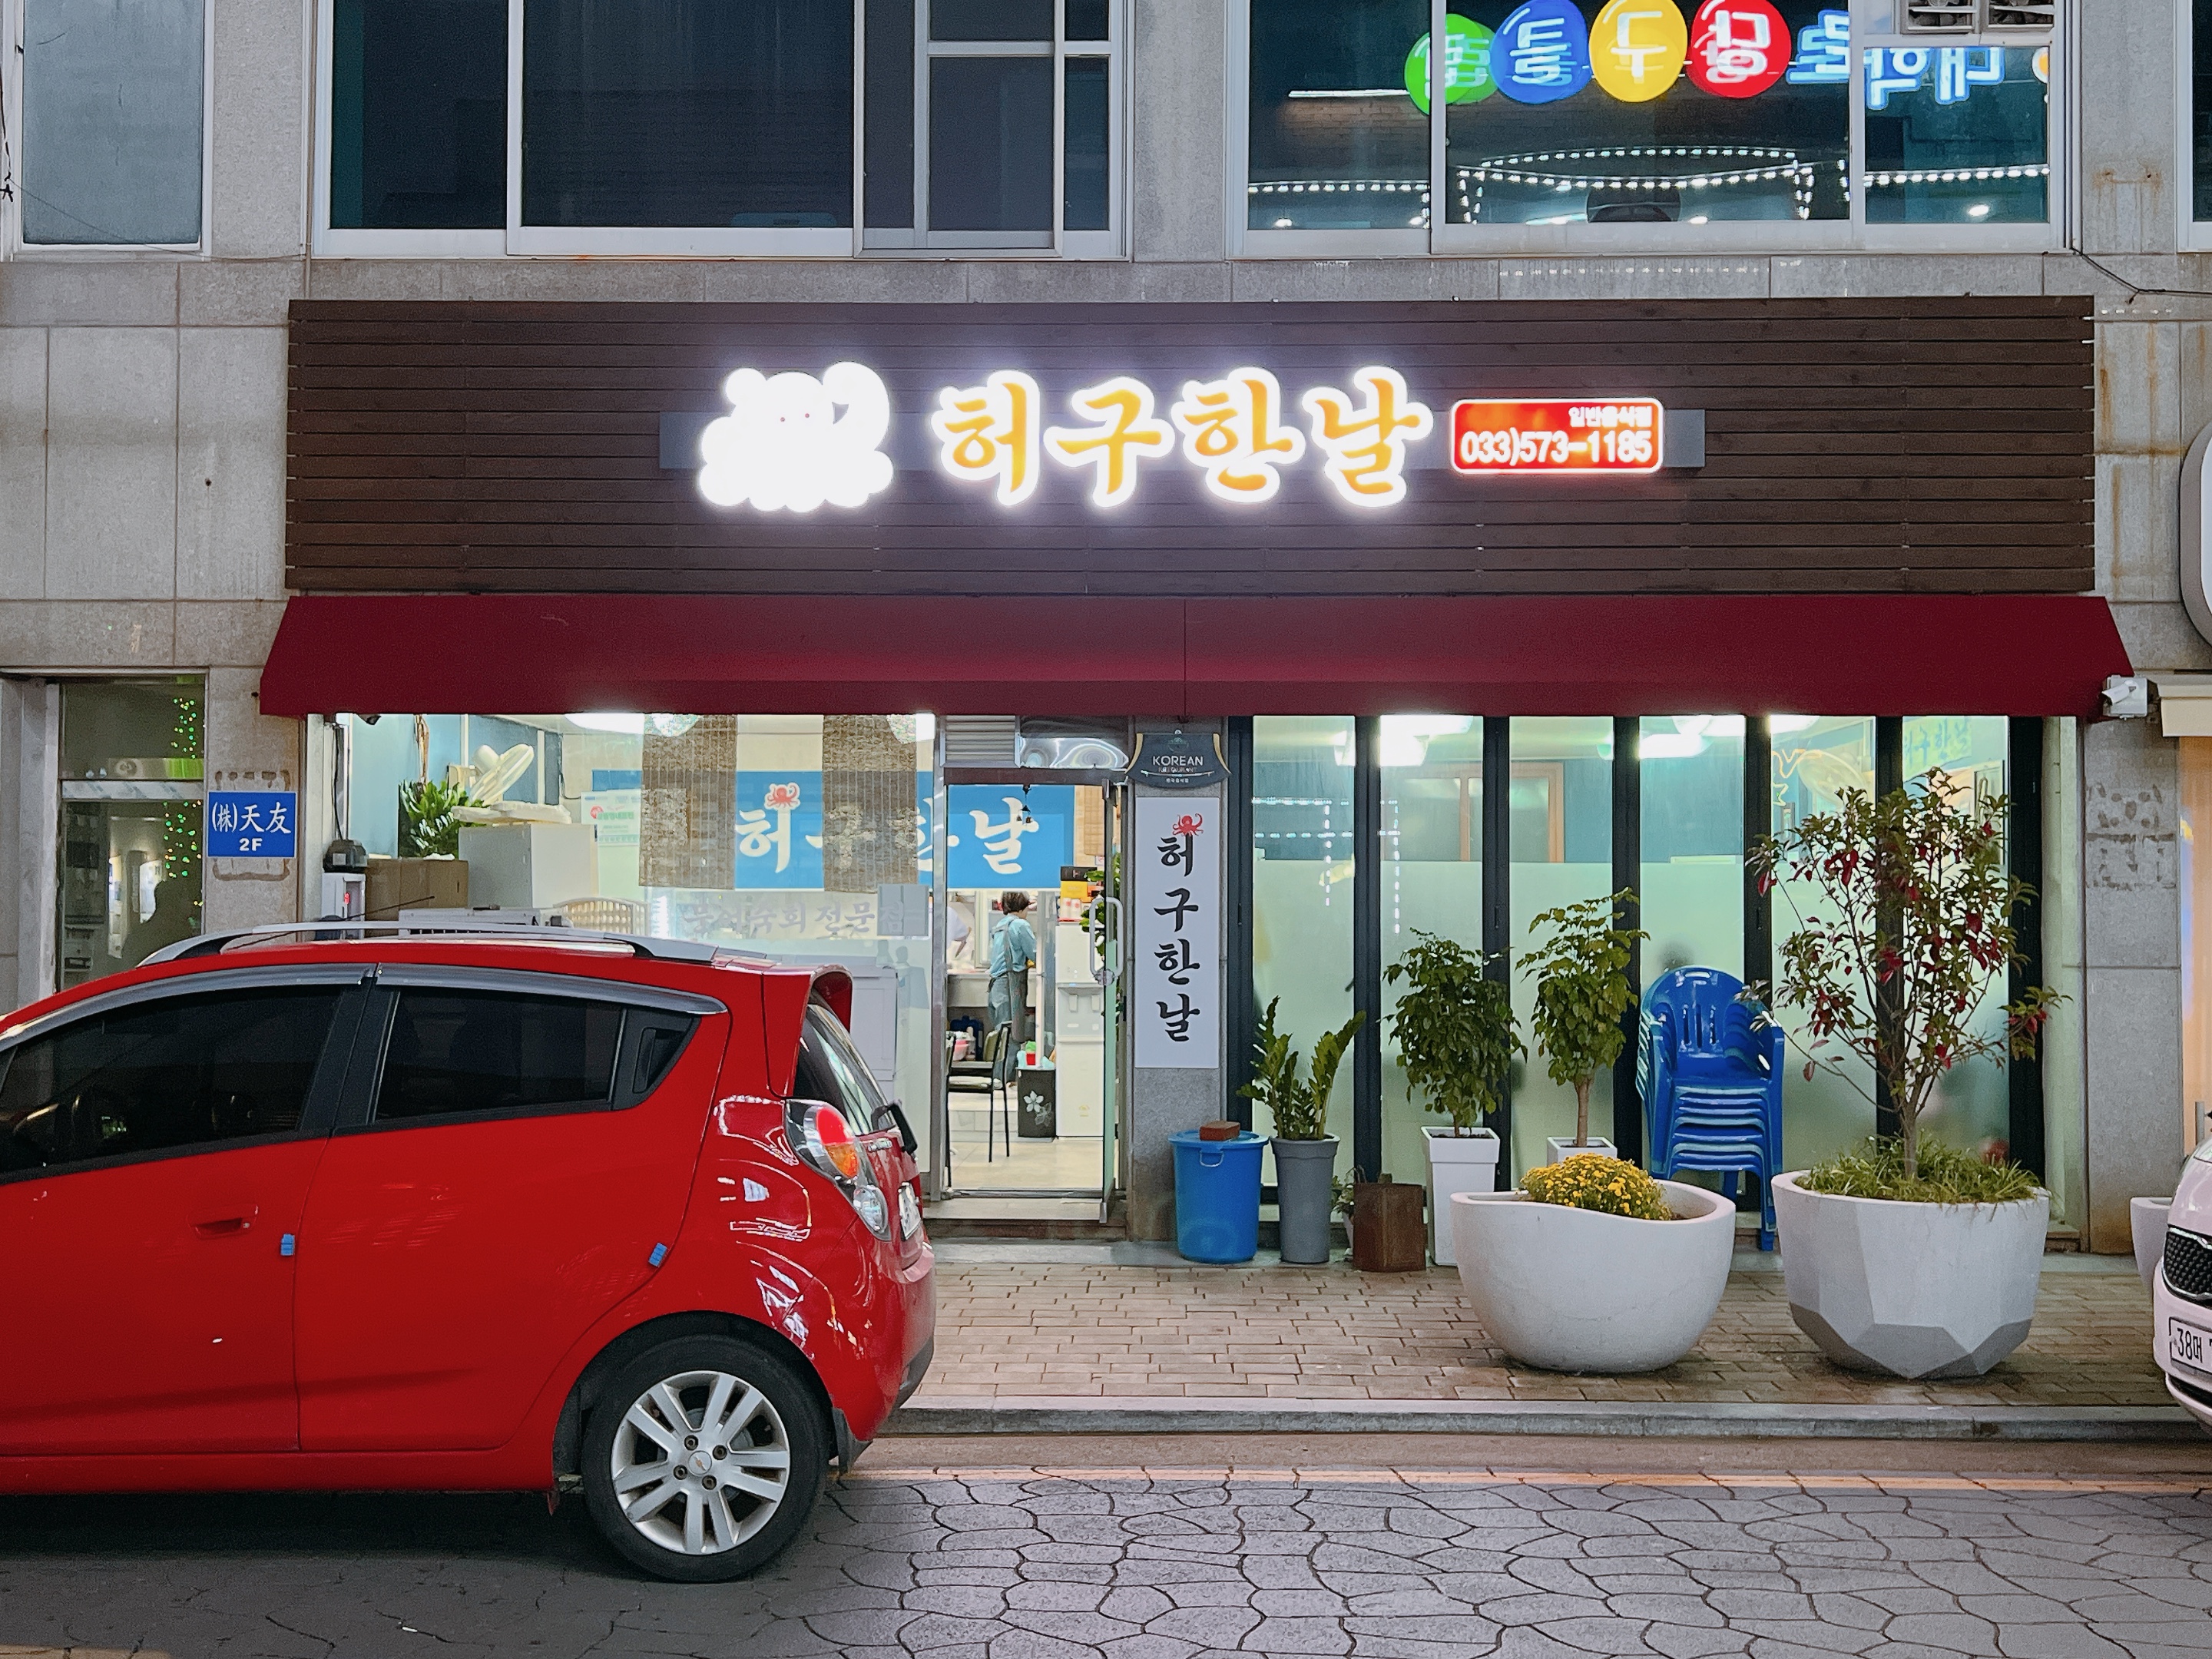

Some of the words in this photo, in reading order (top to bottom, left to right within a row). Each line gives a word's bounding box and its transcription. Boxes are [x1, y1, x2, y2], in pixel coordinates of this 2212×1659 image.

[937, 372, 1427, 501] 허구한날
[1461, 427, 1652, 466] 033)573-1185
[1153, 755, 1204, 767] KOREAN
[211, 801, 292, 834] (株)天友
[239, 837, 263, 852] 2F
[1154, 834, 1200, 1043] 허구한날
